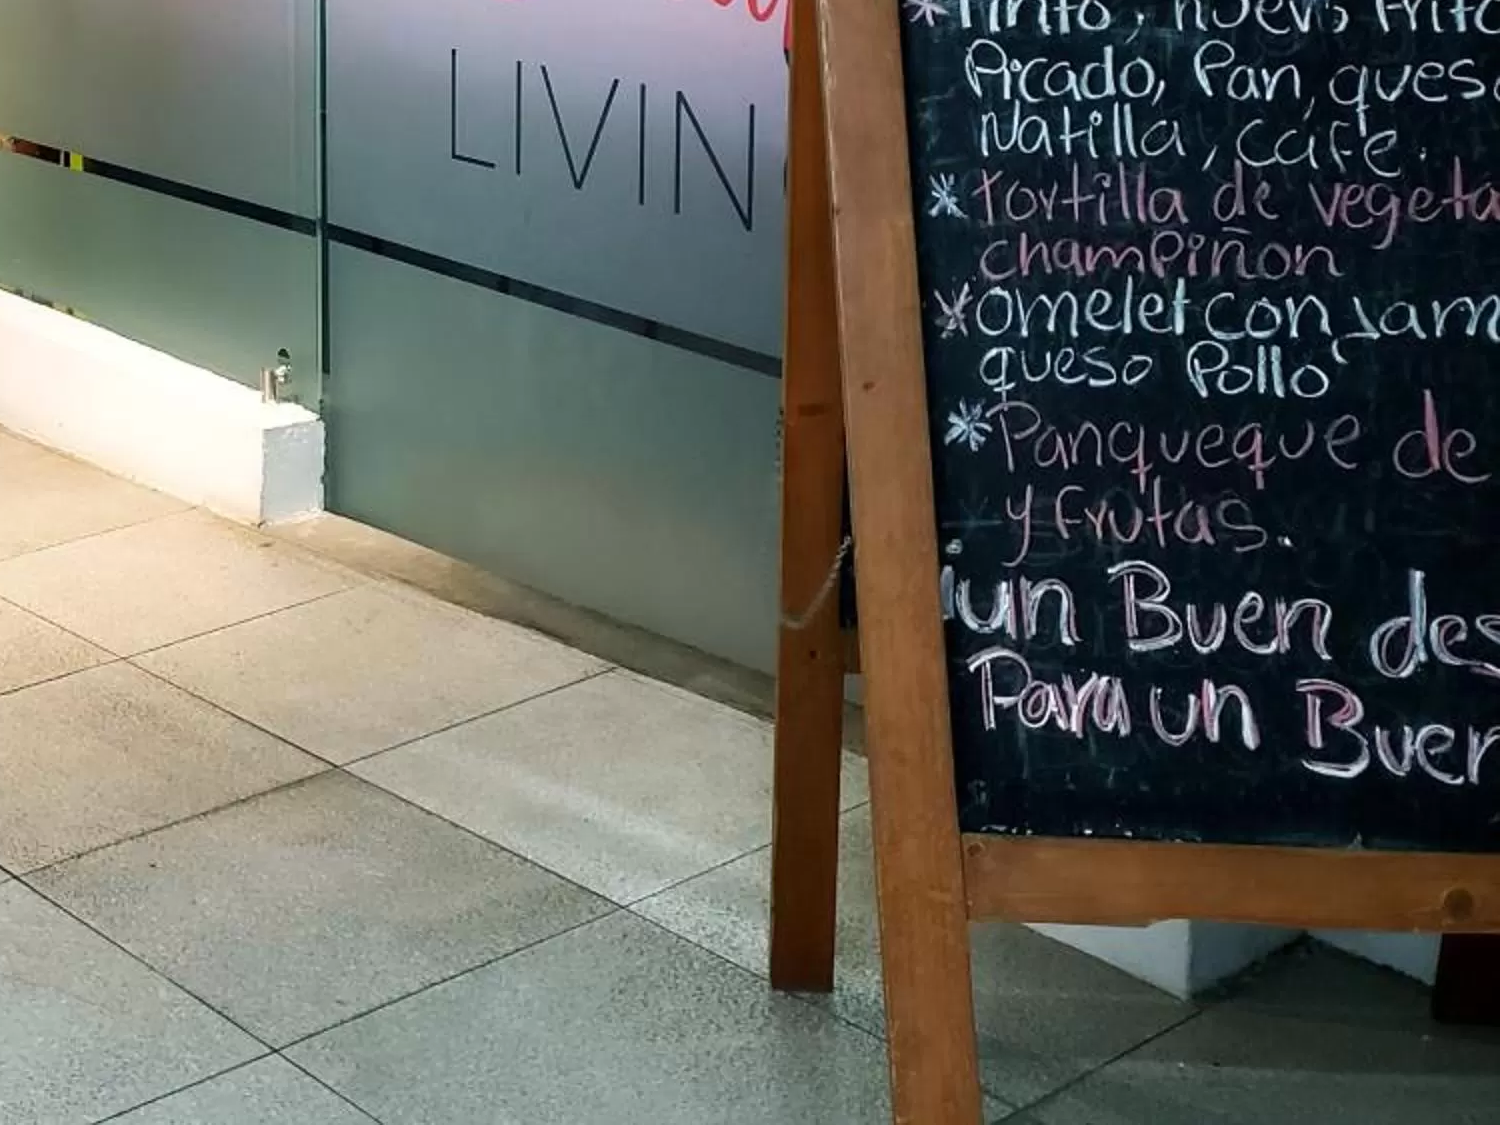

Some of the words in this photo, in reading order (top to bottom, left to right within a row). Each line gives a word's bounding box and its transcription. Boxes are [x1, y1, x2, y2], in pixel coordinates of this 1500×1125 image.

[450, 47, 789, 232] LIVIN
[1327, 59, 1500, 137] ques
[1212, 158, 1280, 223] de
[1393, 388, 1490, 483] de
[1107, 560, 1334, 660] Buen
[967, 645, 1130, 739] Para
[1150, 679, 1261, 750] un
